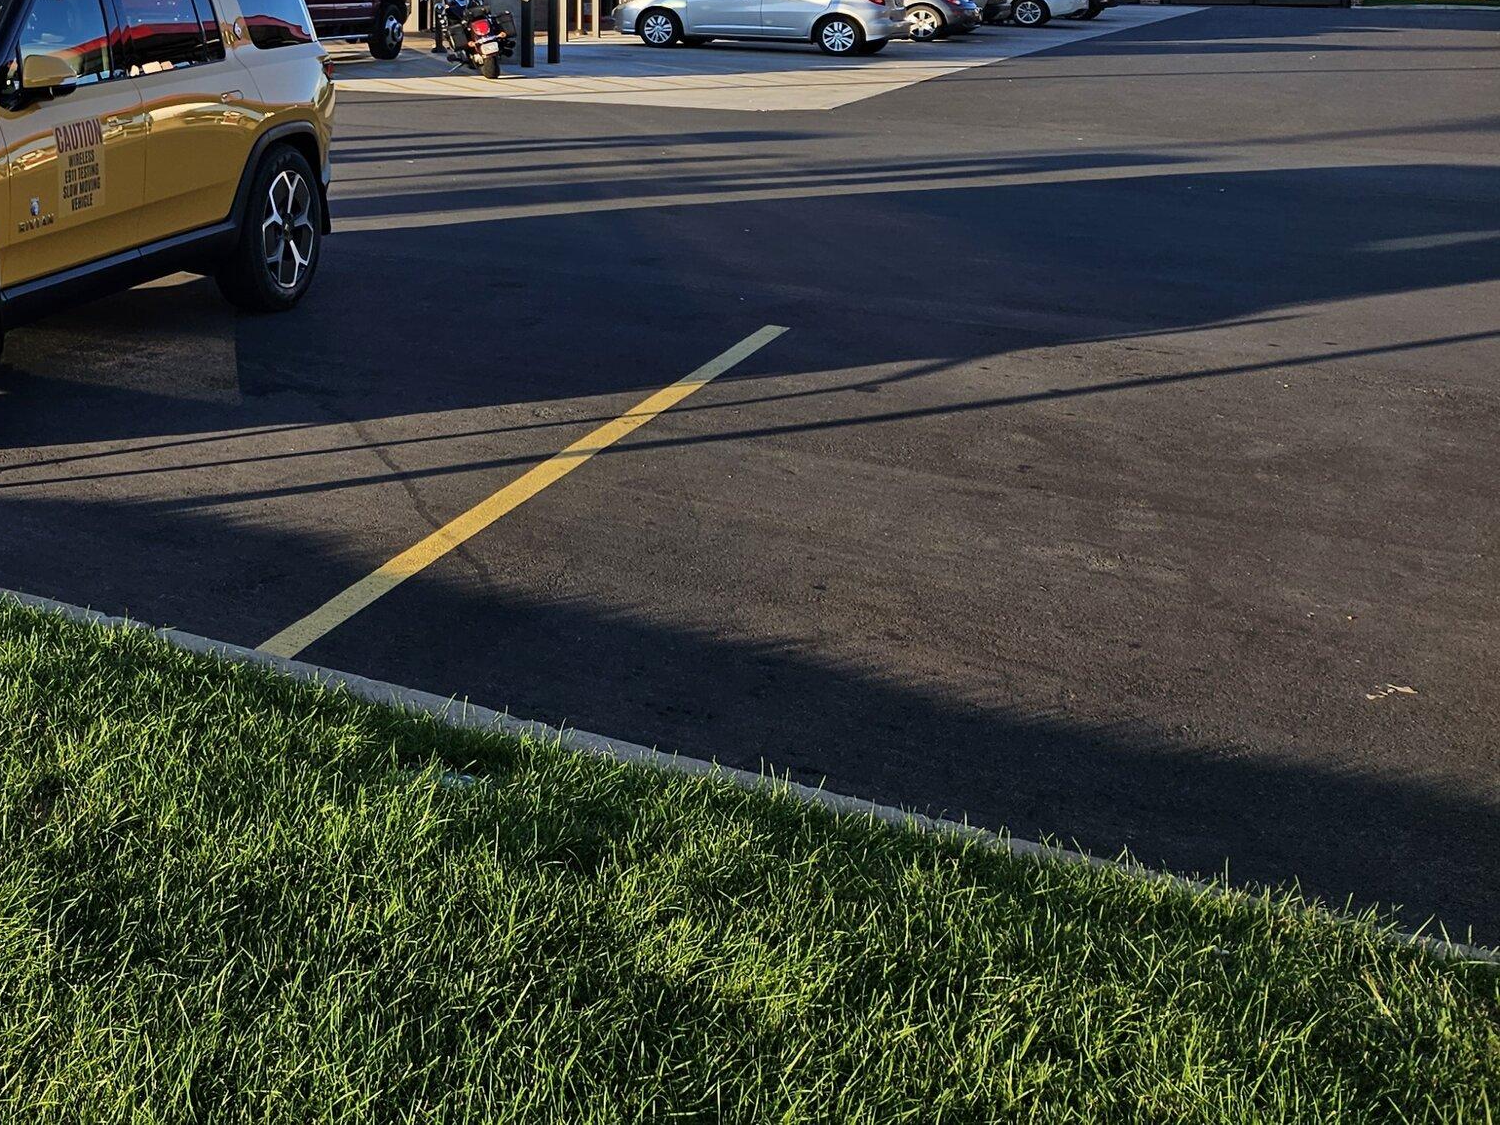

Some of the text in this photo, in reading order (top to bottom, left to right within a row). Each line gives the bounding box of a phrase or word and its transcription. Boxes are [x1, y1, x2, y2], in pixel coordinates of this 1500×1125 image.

[54, 118, 103, 154] CAUTION
[68, 149, 95, 168] WIRELESS
[77, 163, 99, 182] TESTING
[63, 177, 101, 199] SLOW MOVING
[71, 193, 93, 211] VEHICLE
[18, 213, 55, 233] RIVIAN
